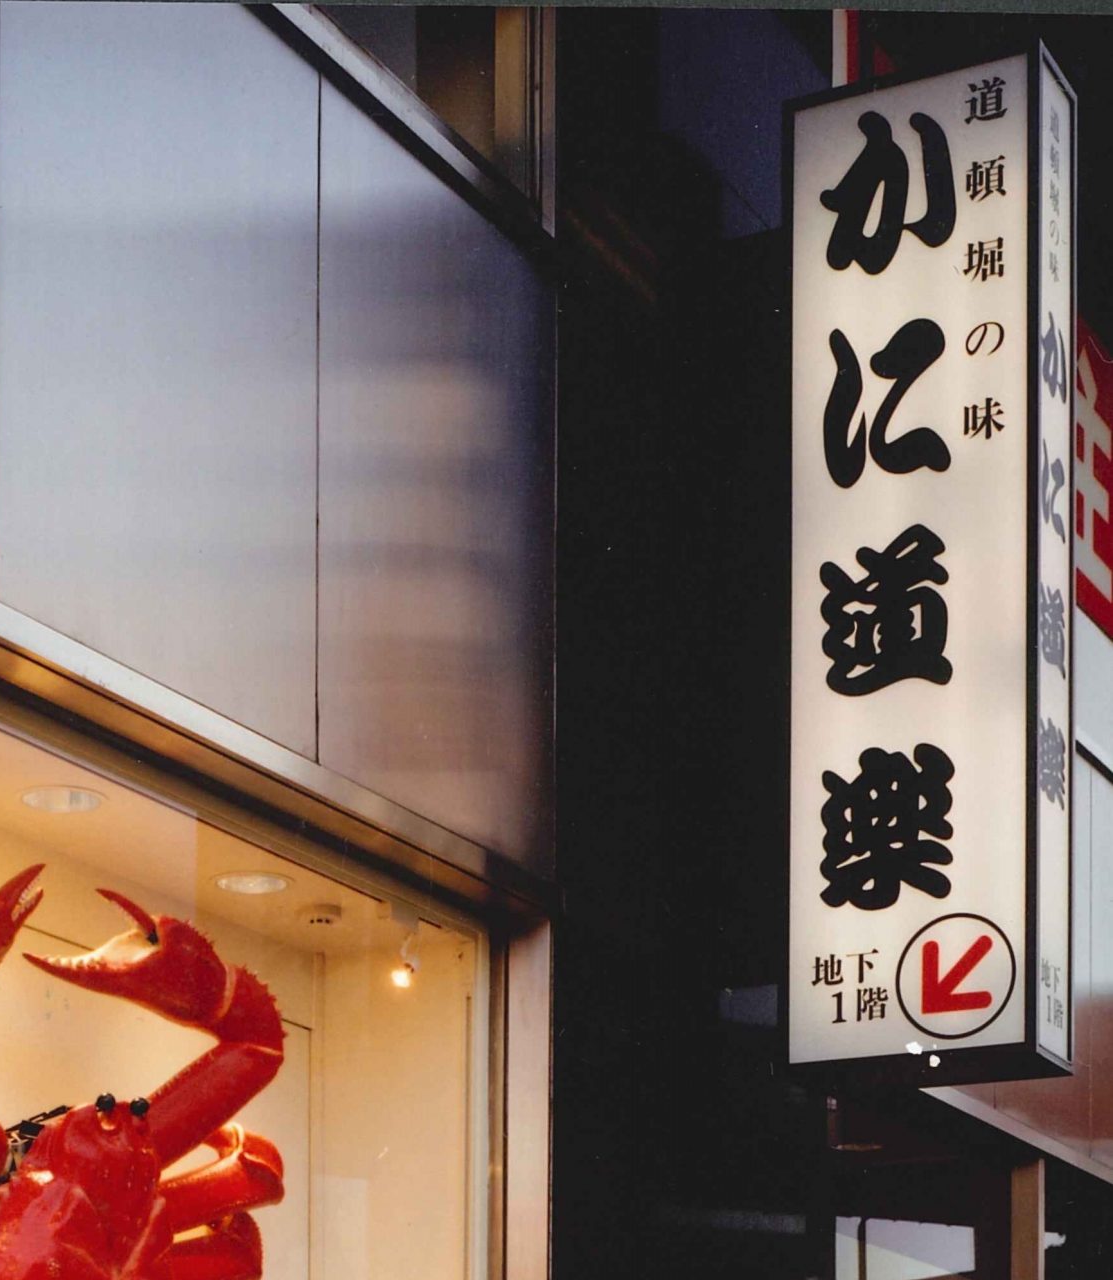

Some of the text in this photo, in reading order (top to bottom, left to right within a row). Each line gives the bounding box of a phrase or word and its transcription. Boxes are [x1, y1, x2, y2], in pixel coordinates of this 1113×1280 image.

[963, 77, 1008, 440] 道頓堀の味
[820, 111, 956, 911] かに道楽
[811, 948, 879, 987] 地下
[831, 987, 889, 1024] 1階
